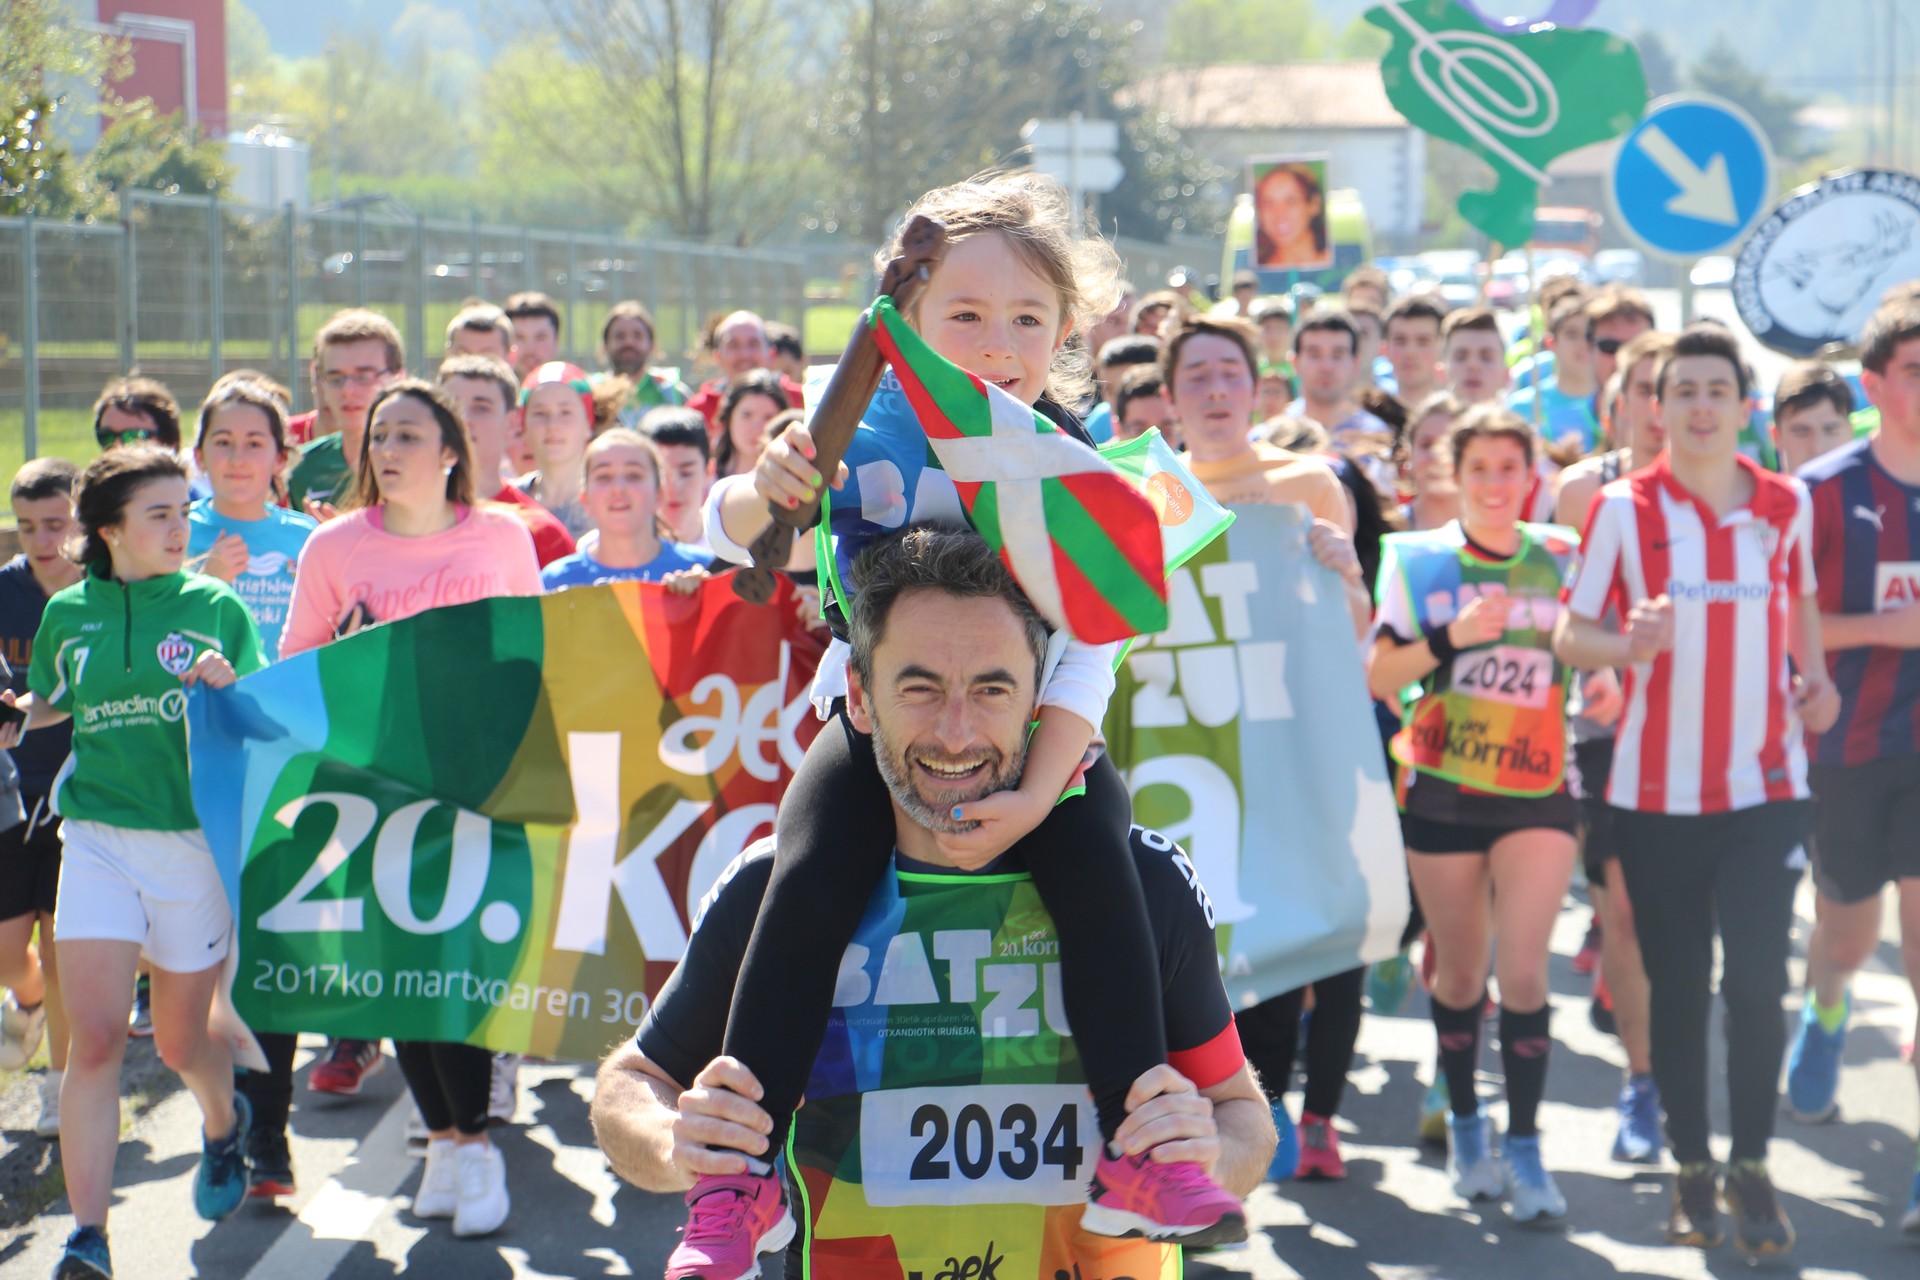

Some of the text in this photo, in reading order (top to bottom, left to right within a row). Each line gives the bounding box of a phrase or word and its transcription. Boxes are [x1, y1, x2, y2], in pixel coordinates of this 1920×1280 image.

[1152, 479, 1185, 519] euskaltel
[1668, 580, 1771, 599] Petronor
[73, 646, 90, 685] 7
[1129, 641, 1295, 728] ZUK
[1458, 656, 1537, 697] 2024
[1445, 719, 1552, 776] korrika
[256, 791, 522, 945] 20.
[831, 928, 992, 1008] BAT
[999, 941, 1020, 957] 20.
[252, 959, 384, 999] 2017ko
[393, 968, 591, 1021] martxoaren
[877, 1024, 976, 1038] OTXANDIOTIK IRUÑERA
[909, 1102, 1084, 1181] 2034
[935, 1240, 1005, 1280] aek
